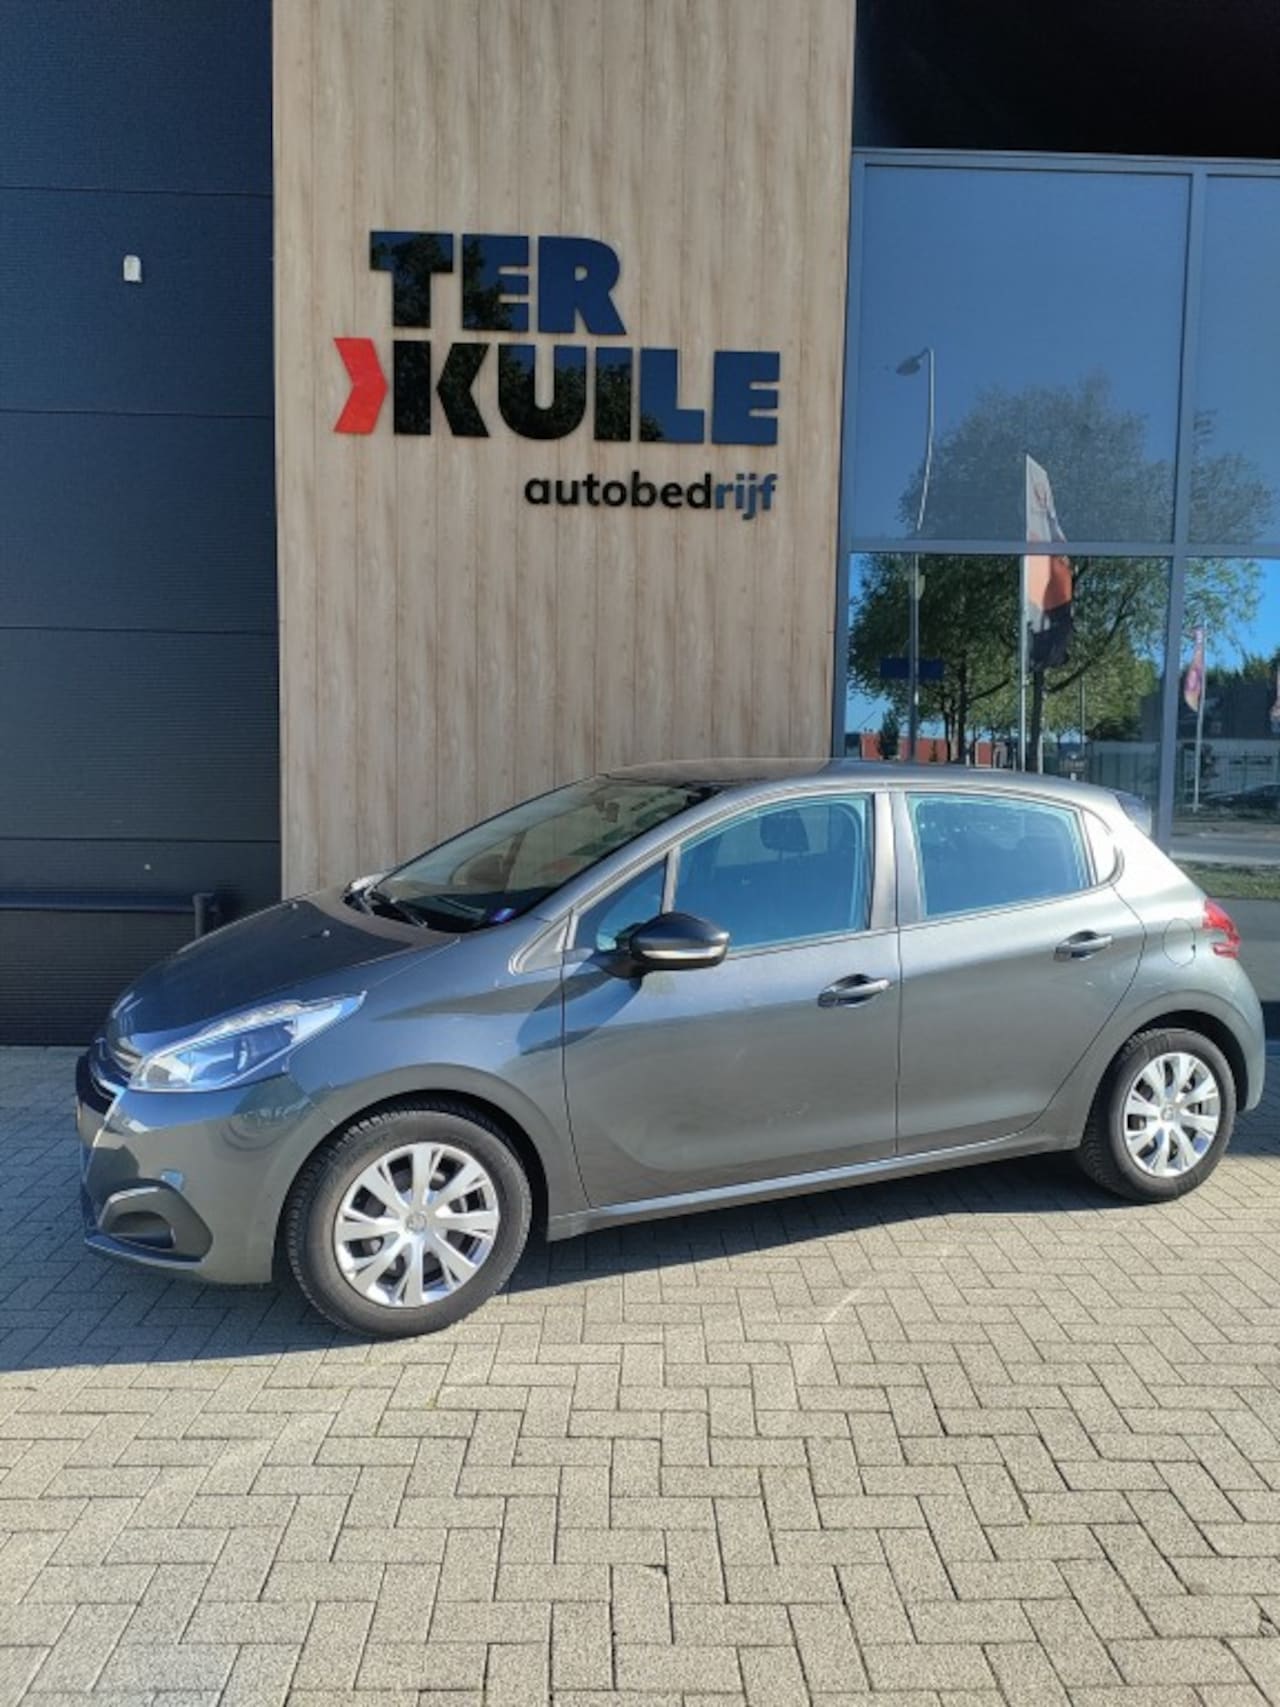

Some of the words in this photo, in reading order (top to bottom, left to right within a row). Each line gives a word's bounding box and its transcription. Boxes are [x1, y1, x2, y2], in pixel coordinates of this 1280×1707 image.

[370, 231, 627, 335] TER
[393, 340, 780, 446] KUILE
[524, 471, 777, 520] autobedrijf
